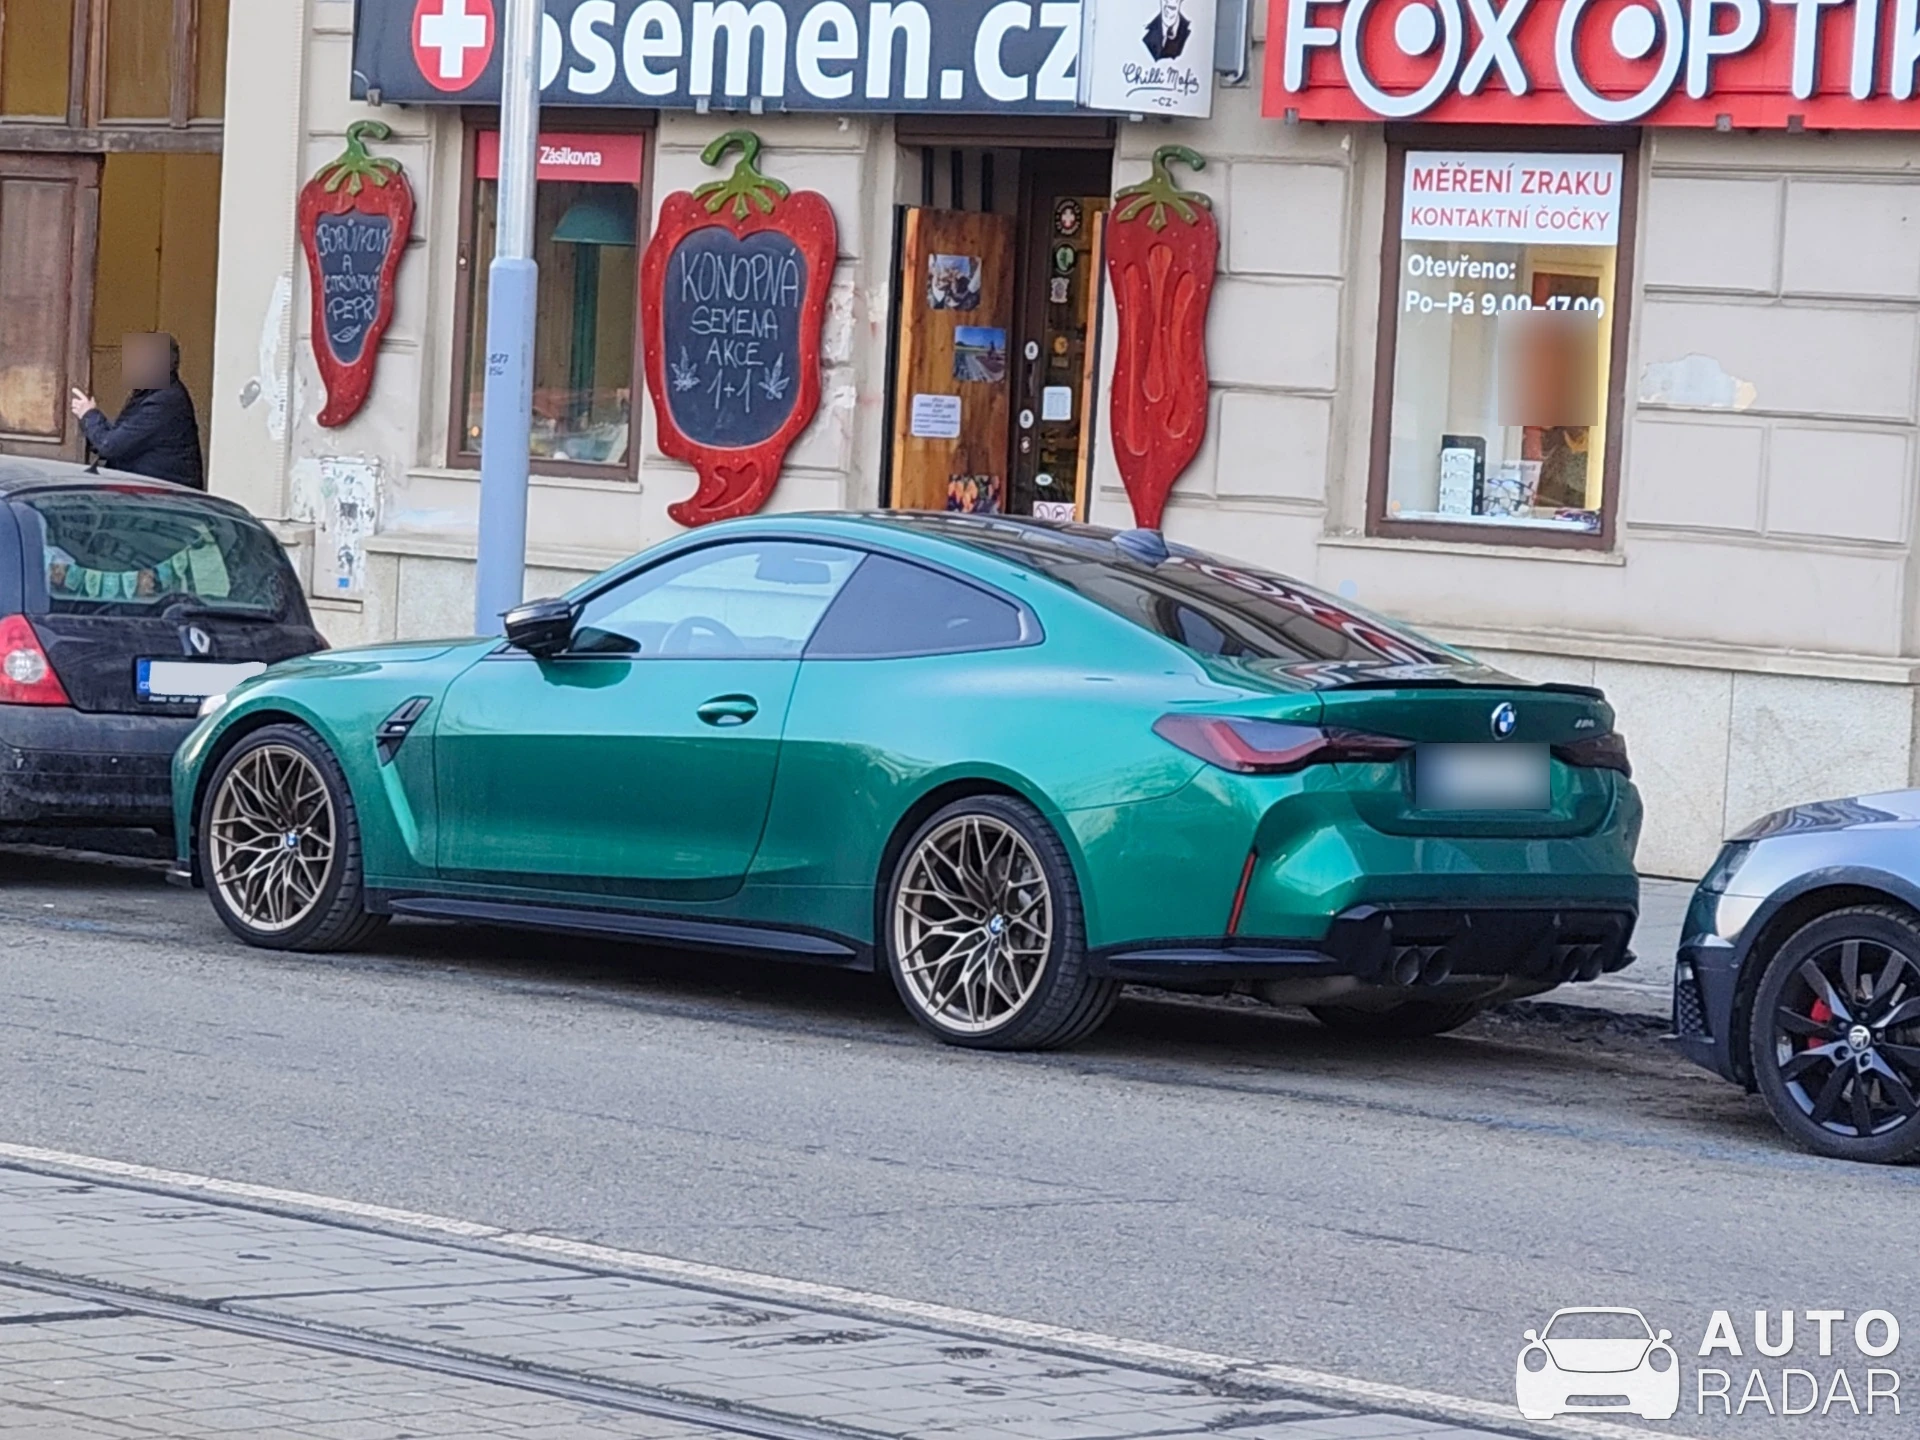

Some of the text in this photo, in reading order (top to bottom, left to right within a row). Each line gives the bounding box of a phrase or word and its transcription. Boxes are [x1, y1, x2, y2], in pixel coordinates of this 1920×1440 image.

[1122, 62, 1165, 85] Chilli
[1283, 0, 1528, 117] FOX
[539, 146, 602, 166] Zásilkovna
[1411, 161, 1613, 196] MĚŘENÍ ZRAKU
[1410, 204, 1611, 232] KONTAKTNÍ ČOČKY
[681, 247, 799, 308] KONOPNÁ
[1407, 254, 1517, 281] Otevřeno:
[690, 305, 779, 341] SEMENA
[705, 337, 765, 369] AKCE
[707, 368, 751, 413] 1+1
